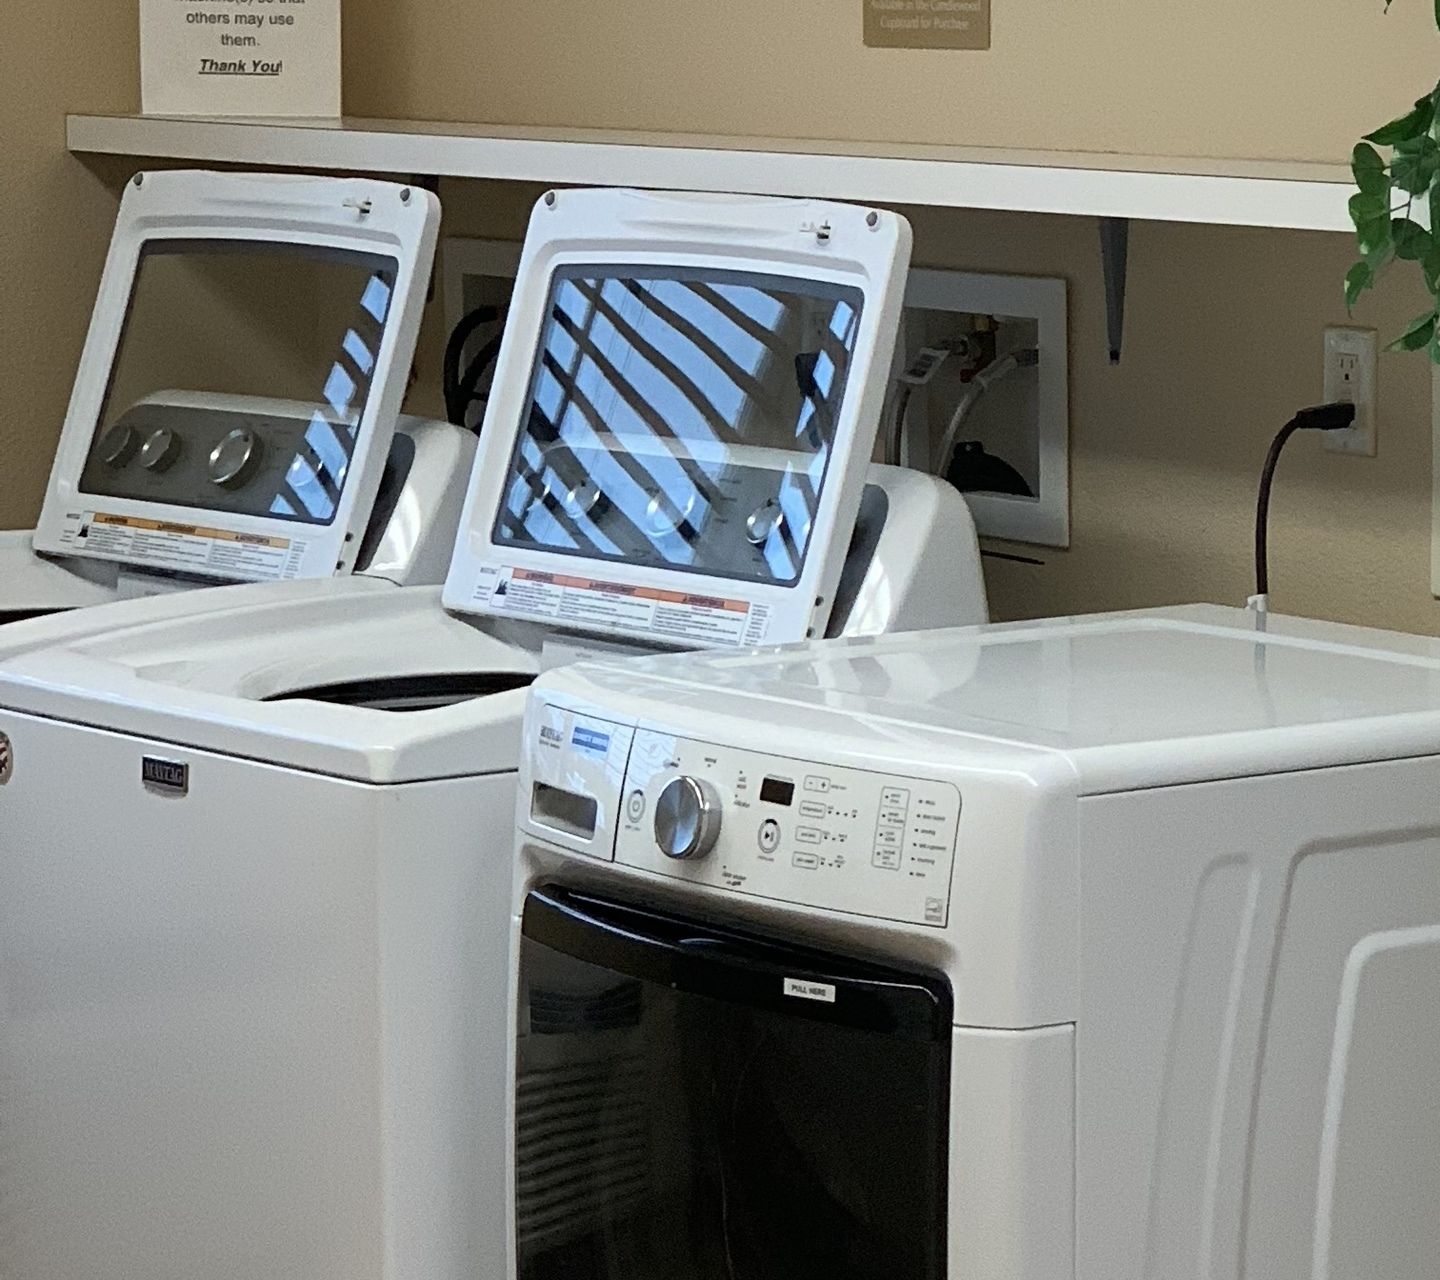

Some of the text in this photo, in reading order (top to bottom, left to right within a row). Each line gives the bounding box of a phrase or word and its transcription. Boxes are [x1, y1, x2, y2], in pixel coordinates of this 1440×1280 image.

[186, 12, 294, 27] others may use
[221, 34, 261, 46] them.
[200, 58, 283, 73] Thank You!
